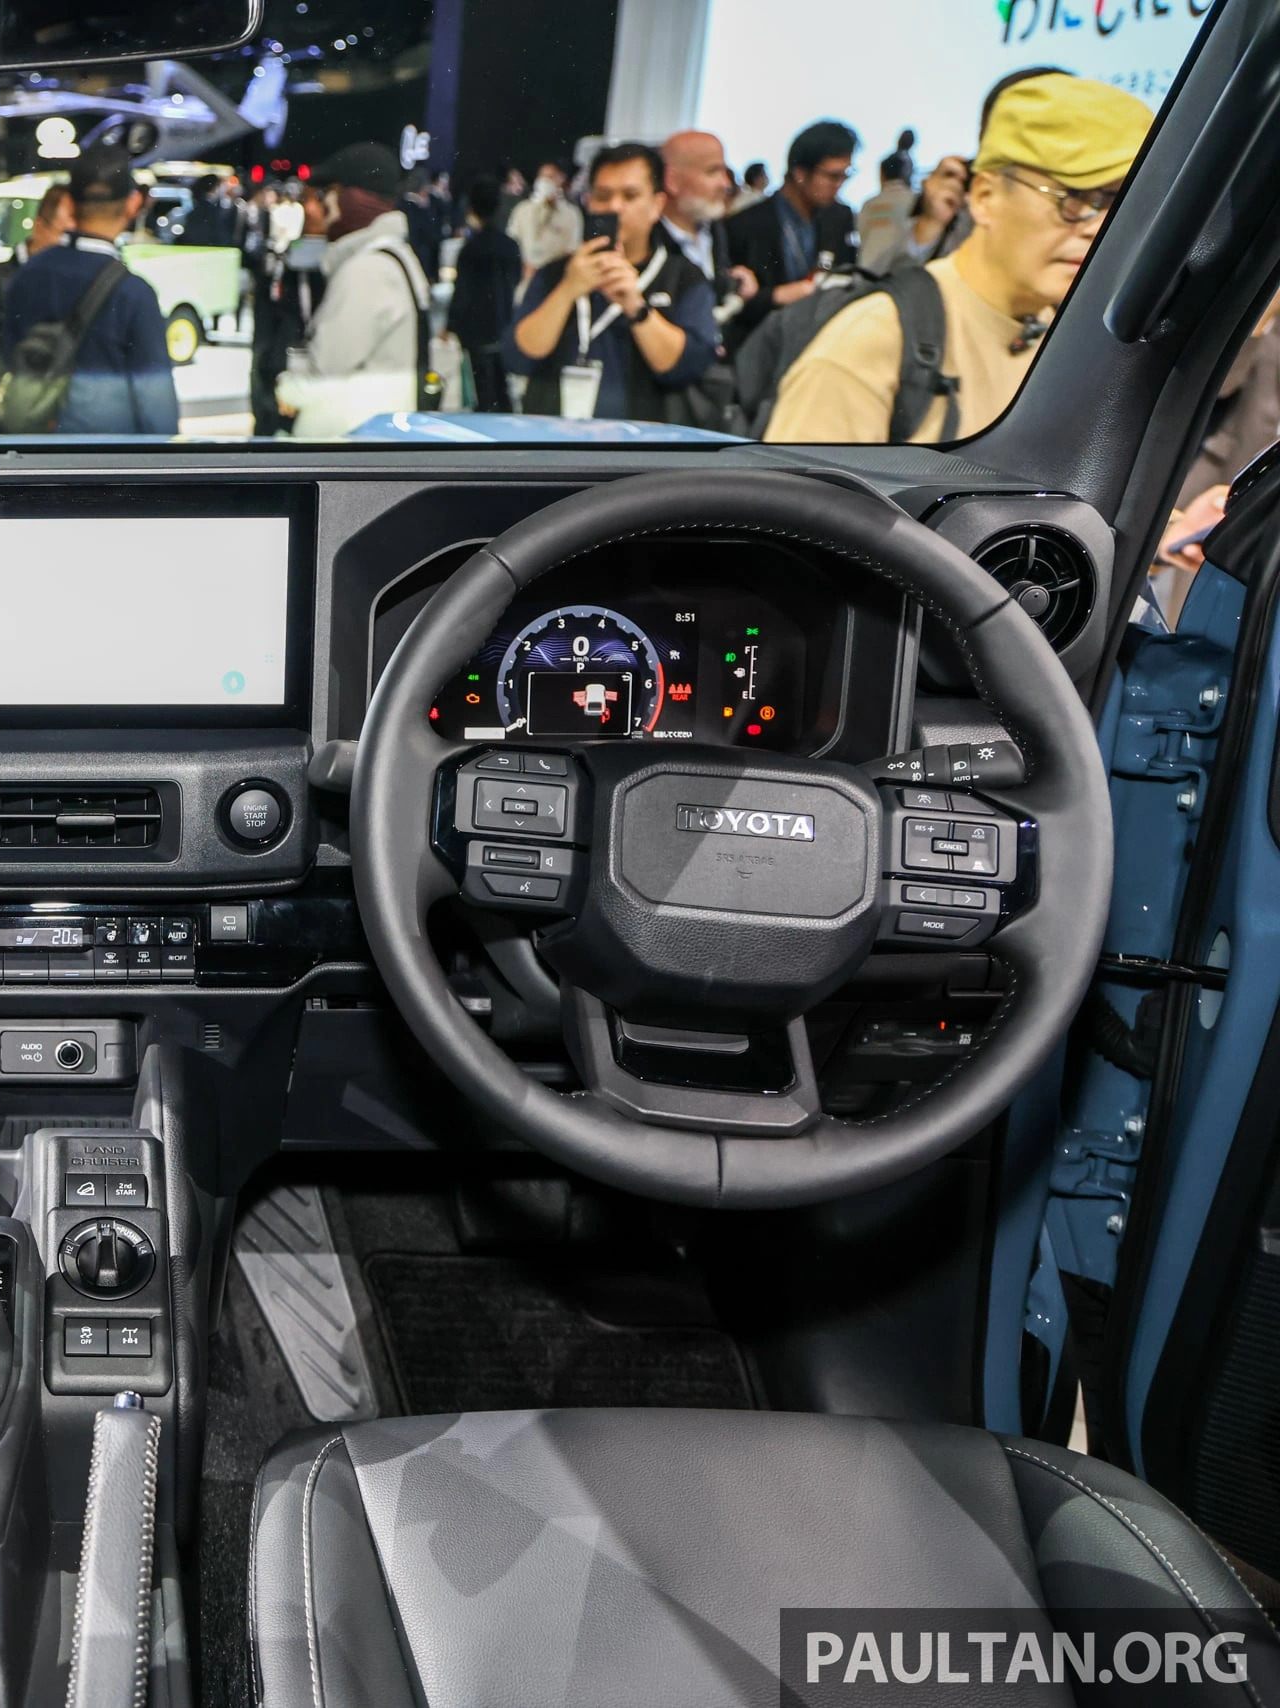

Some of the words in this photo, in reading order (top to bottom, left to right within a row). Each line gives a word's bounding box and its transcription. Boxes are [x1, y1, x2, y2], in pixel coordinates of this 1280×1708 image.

[674, 613, 696, 622] 8:51
[557, 619, 566, 629] 3
[597, 619, 606, 629] 4
[523, 641, 531, 651] 2
[572, 635, 590, 657] 0
[631, 641, 639, 651] 5
[744, 646, 751, 654] F
[576, 662, 585, 674] P
[644, 679, 653, 689] 6
[671, 693, 689, 701] REAR
[742, 690, 749, 699] E
[634, 717, 642, 727] 7
[953, 775, 970, 783] AUTO
[243, 804, 268, 812] ENGINE
[514, 803, 526, 811] OK
[243, 812, 267, 820] START
[246, 820, 266, 828] STOP
[678, 807, 813, 839] TOYOTA
[938, 842, 963, 851] CANCEL
[922, 921, 945, 930] MODE
[51, 929, 79, 945] 20.5
[167, 931, 188, 940] AUTO
[84, 1145, 126, 1155] LAND
[71, 1156, 140, 1167] CRUISER
[64, 1244, 74, 1255] H2
[138, 1245, 148, 1255] L4
